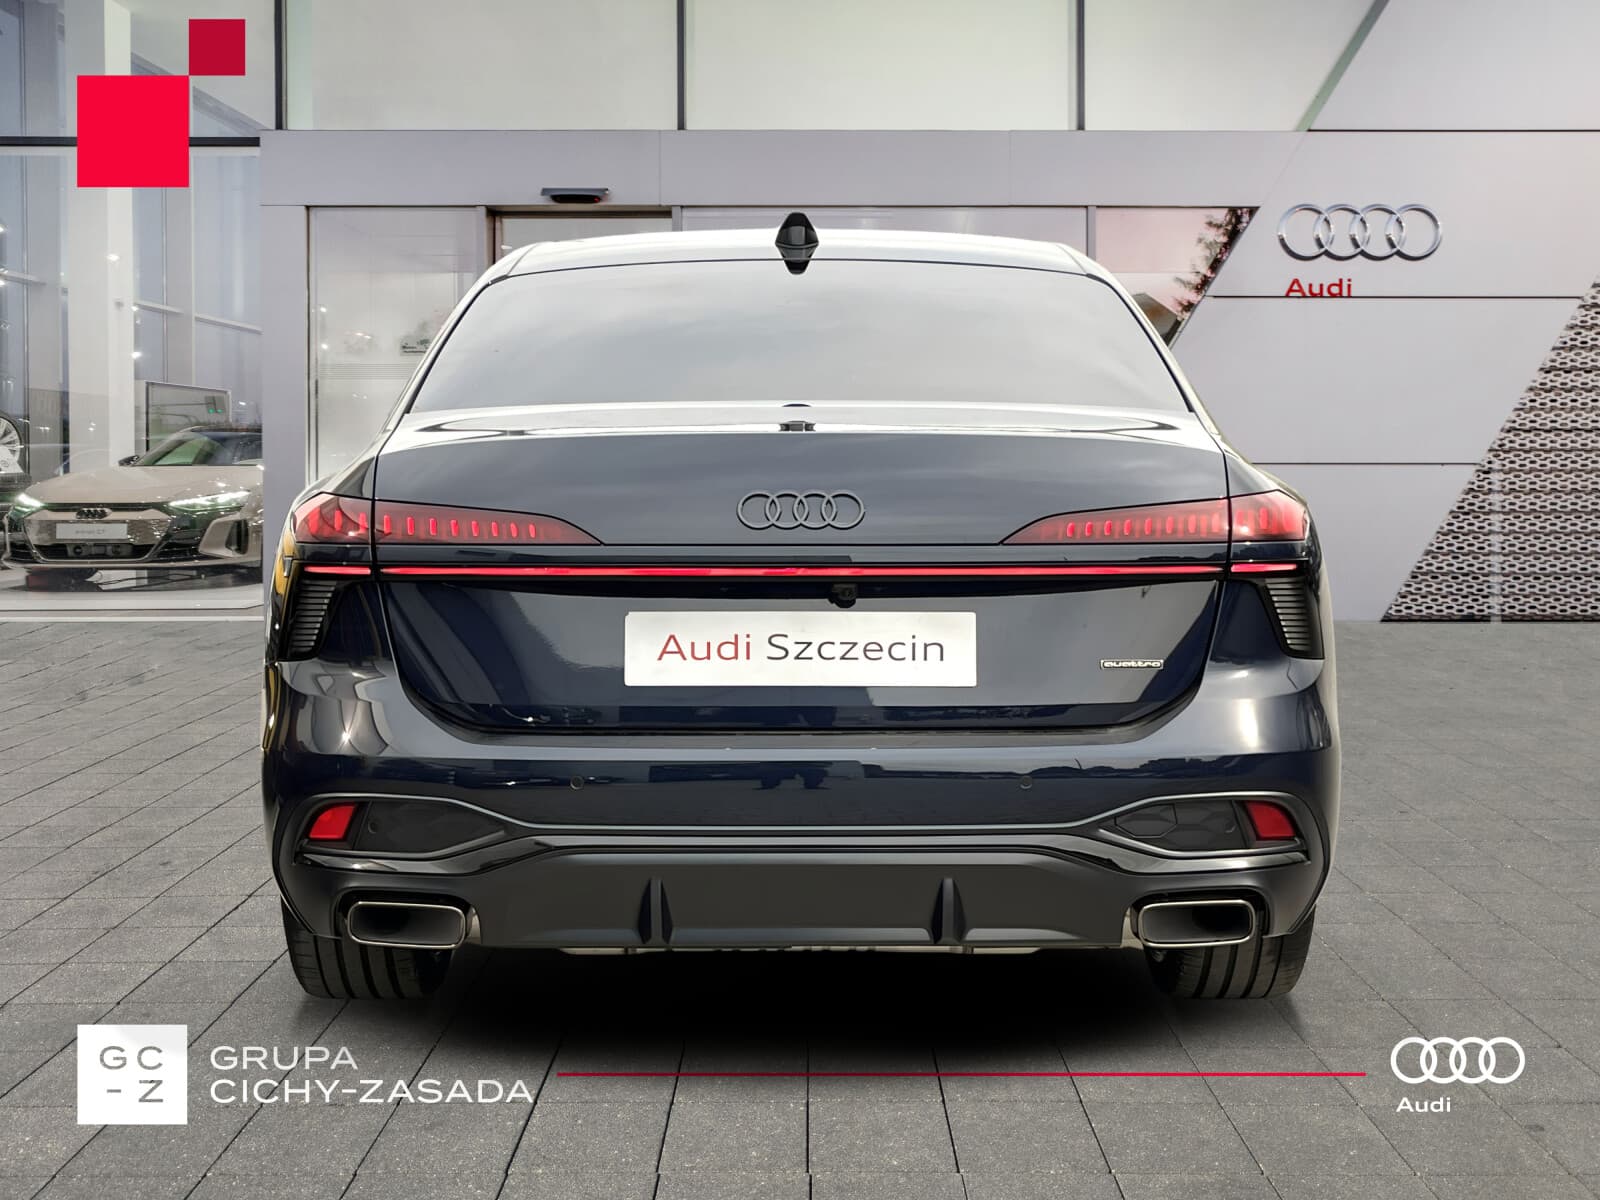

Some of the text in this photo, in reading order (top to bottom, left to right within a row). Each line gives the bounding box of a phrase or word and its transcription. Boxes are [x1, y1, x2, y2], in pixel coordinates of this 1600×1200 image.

[1285, 278, 1353, 298] Audi
[657, 633, 945, 662] Audi Szczecin
[1102, 660, 1162, 669] quattro
